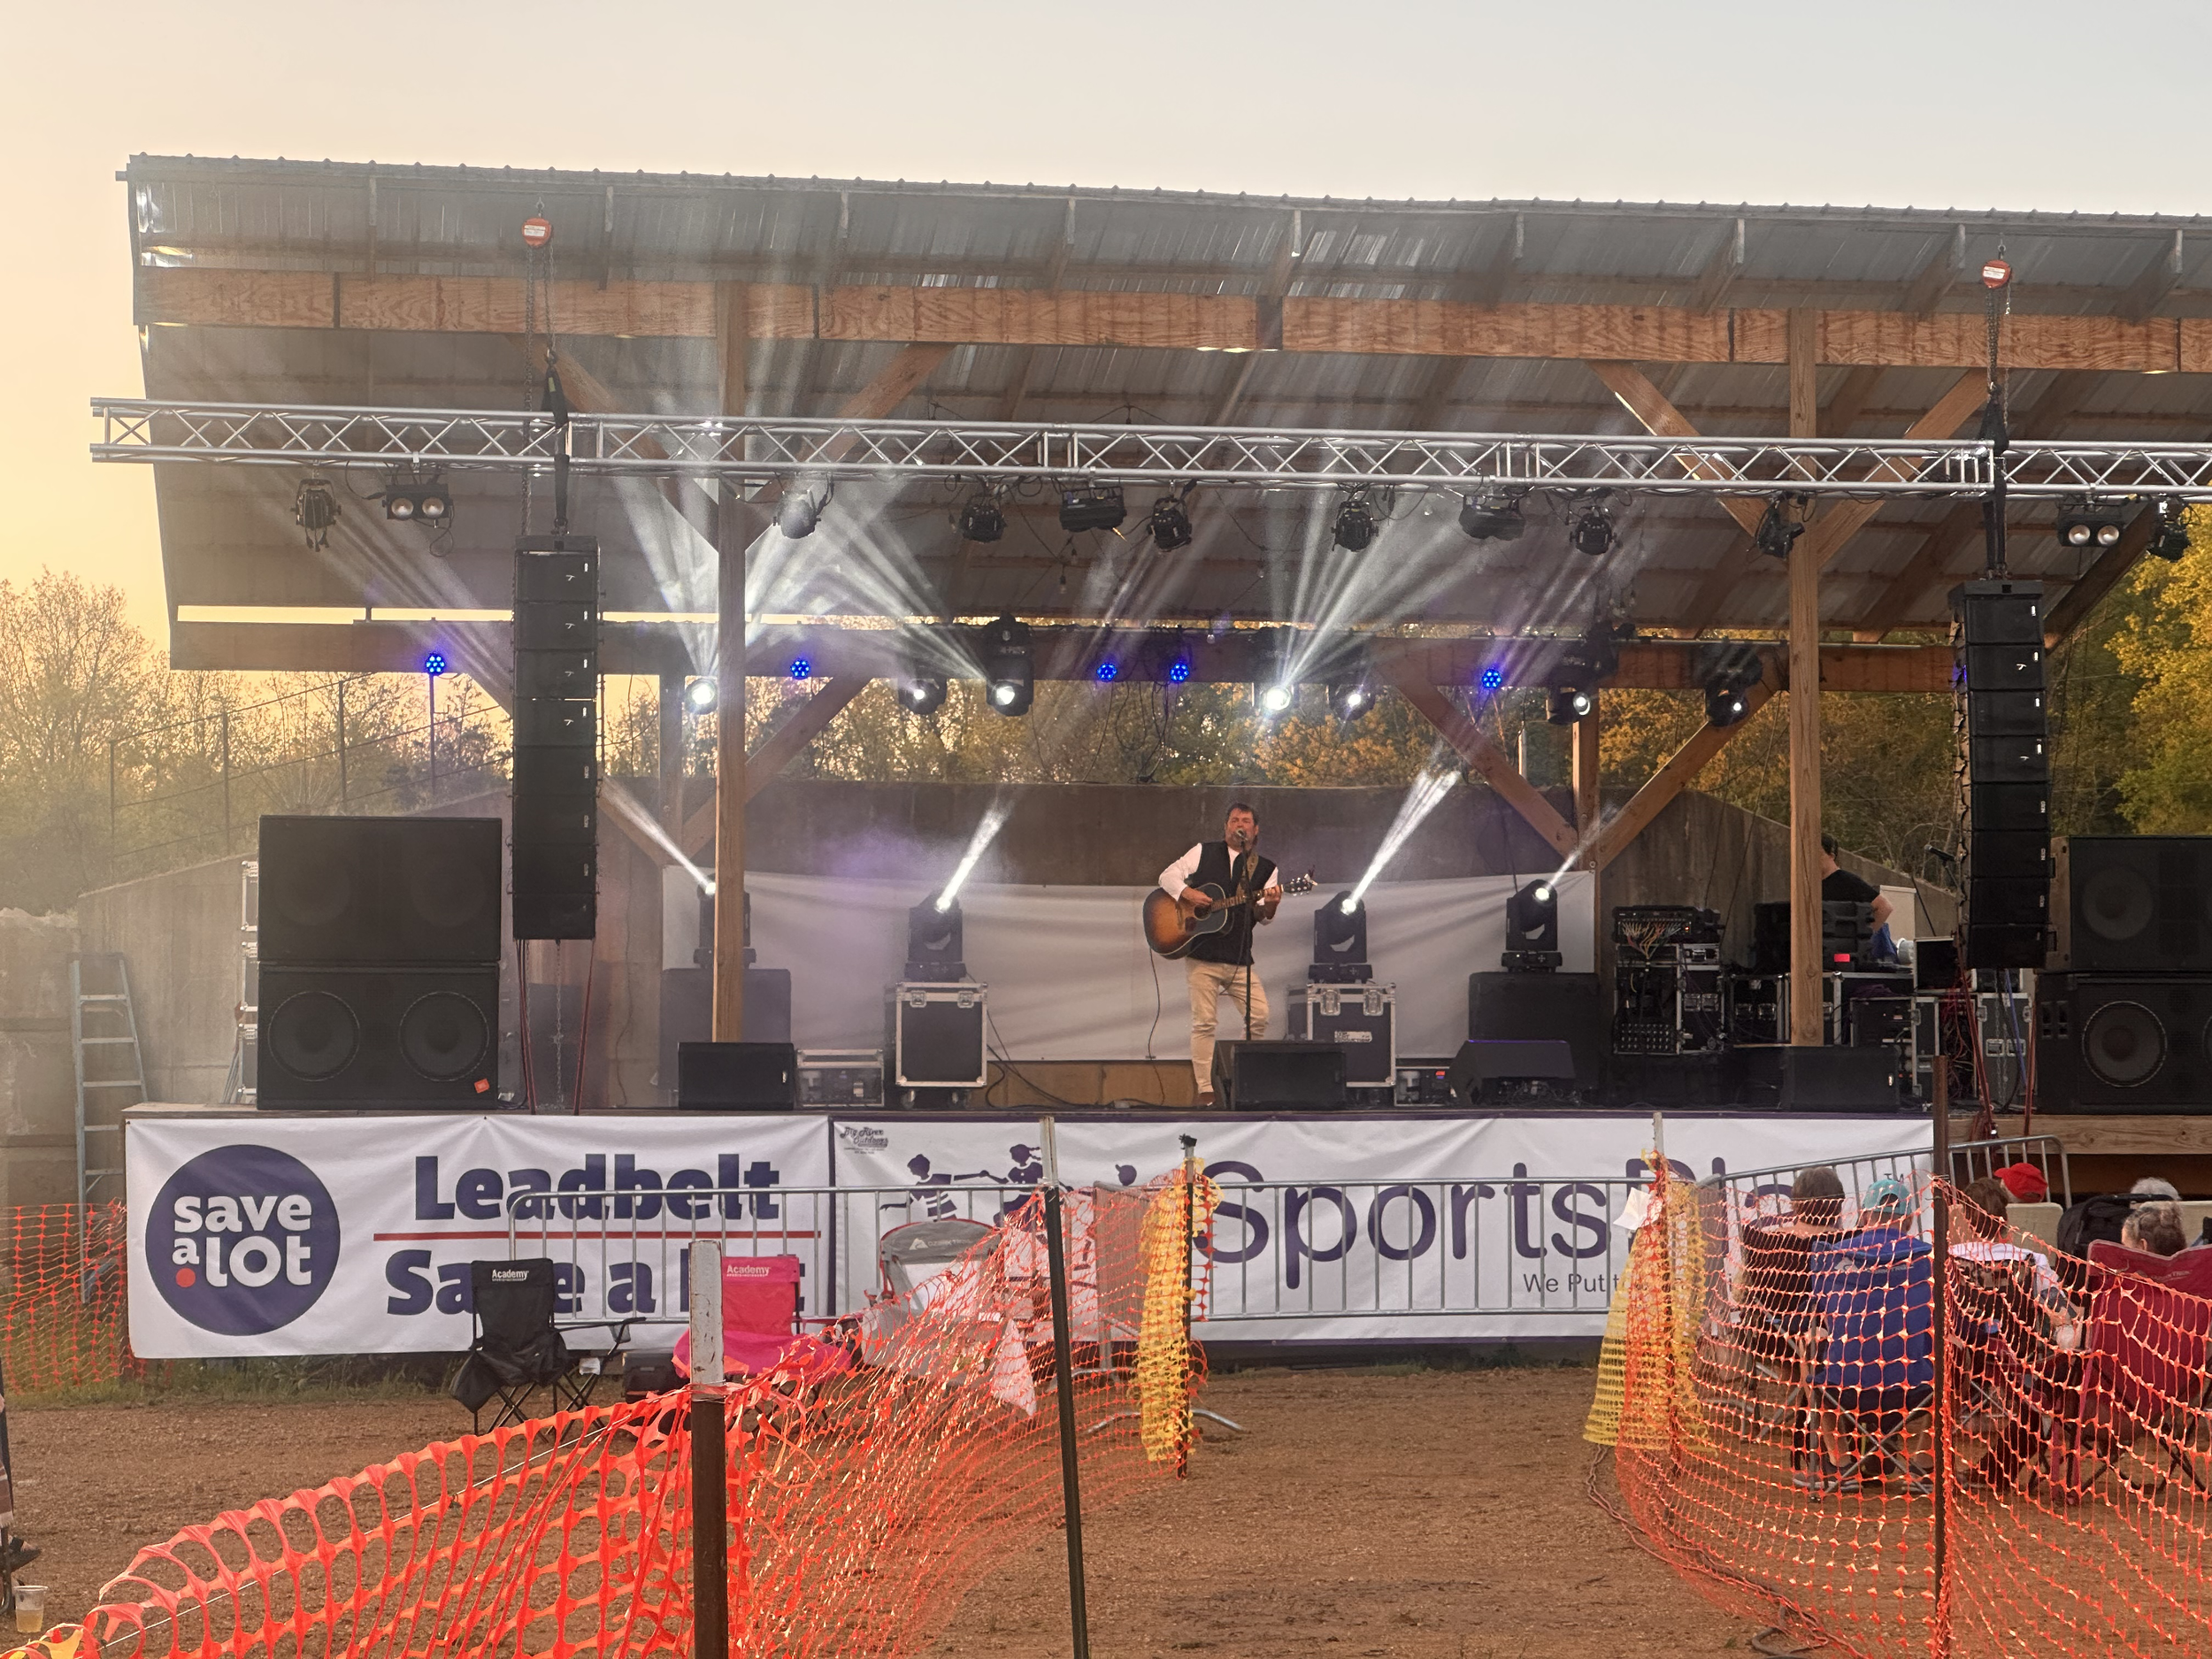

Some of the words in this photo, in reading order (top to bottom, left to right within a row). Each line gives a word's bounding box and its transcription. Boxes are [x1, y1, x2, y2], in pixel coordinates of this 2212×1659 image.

[415, 1153, 780, 1221] Leadbelt
[173, 1194, 312, 1233] save
[172, 1237, 200, 1265] a
[385, 1248, 586, 1316] Sae
[607, 1262, 657, 1314] a
[491, 1269, 528, 1280] Academy
[726, 1264, 771, 1277] Academy
[1523, 1273, 1559, 1293] We
[1568, 1273, 1607, 1293] Put
